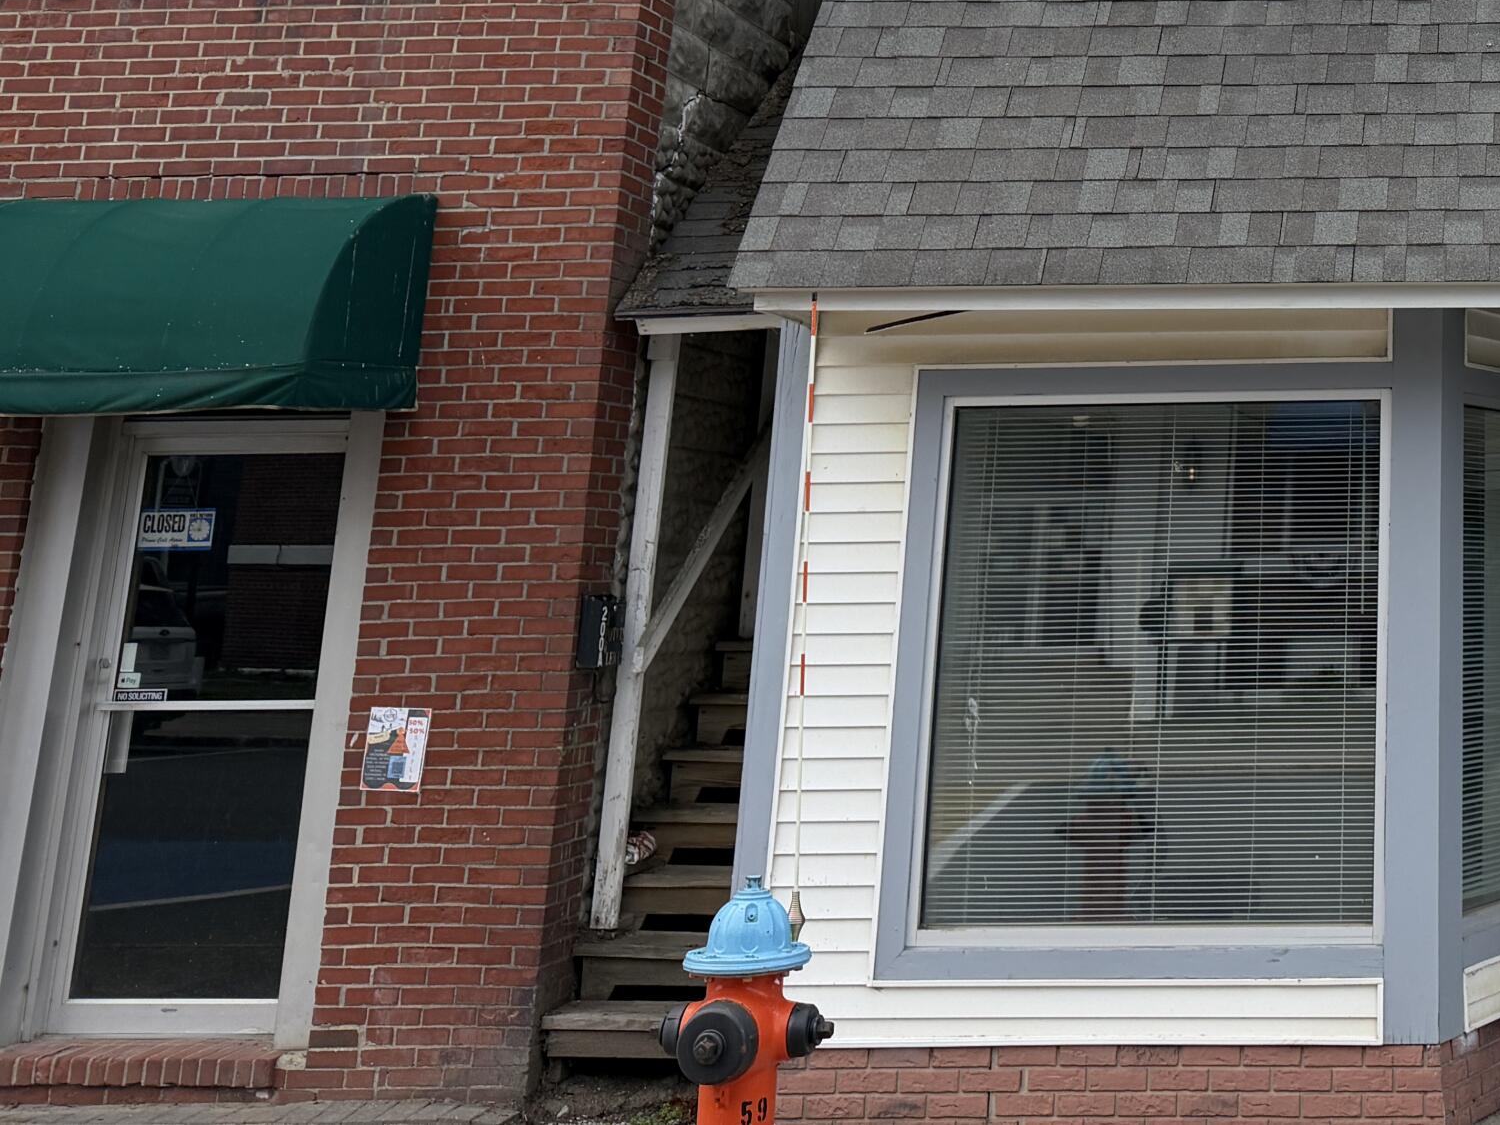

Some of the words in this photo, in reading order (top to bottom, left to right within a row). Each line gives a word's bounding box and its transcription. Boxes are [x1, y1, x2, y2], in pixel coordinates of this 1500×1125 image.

[143, 514, 186, 533] CLOSED
[126, 677, 136, 685] Pay
[117, 692, 127, 700] NO
[128, 692, 163, 700] SOLICITING
[741, 1097, 768, 1125] 59
